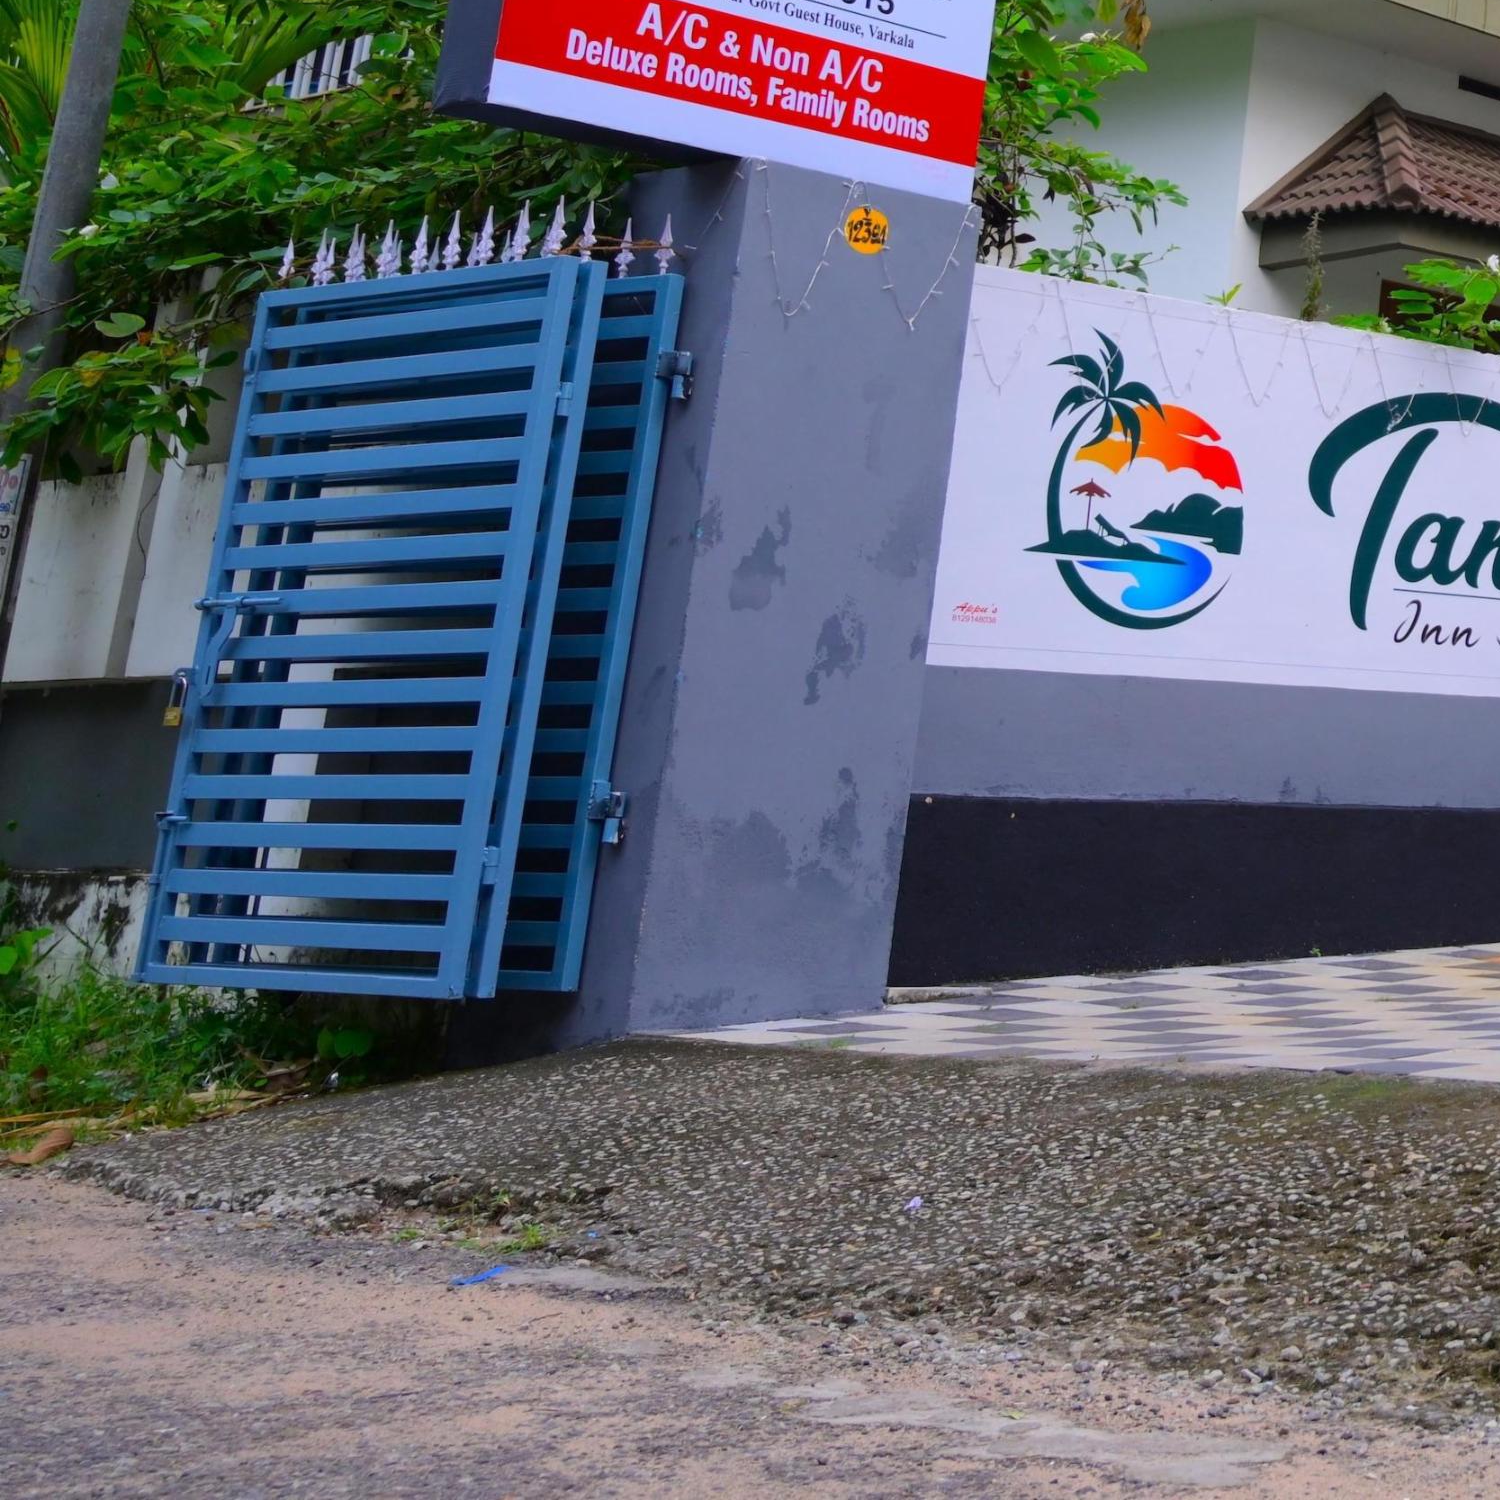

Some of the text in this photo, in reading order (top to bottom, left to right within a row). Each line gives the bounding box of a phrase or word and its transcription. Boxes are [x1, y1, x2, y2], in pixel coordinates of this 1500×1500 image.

[636, 2, 884, 93] A/C & Non A/C
[784, 3, 820, 24] Guest
[823, 13, 864, 38] House,
[869, 23, 915, 49] Varkala
[565, 28, 931, 142] Deluxe Rooms, Family Rooms
[1393, 600, 1480, 649] Inn
